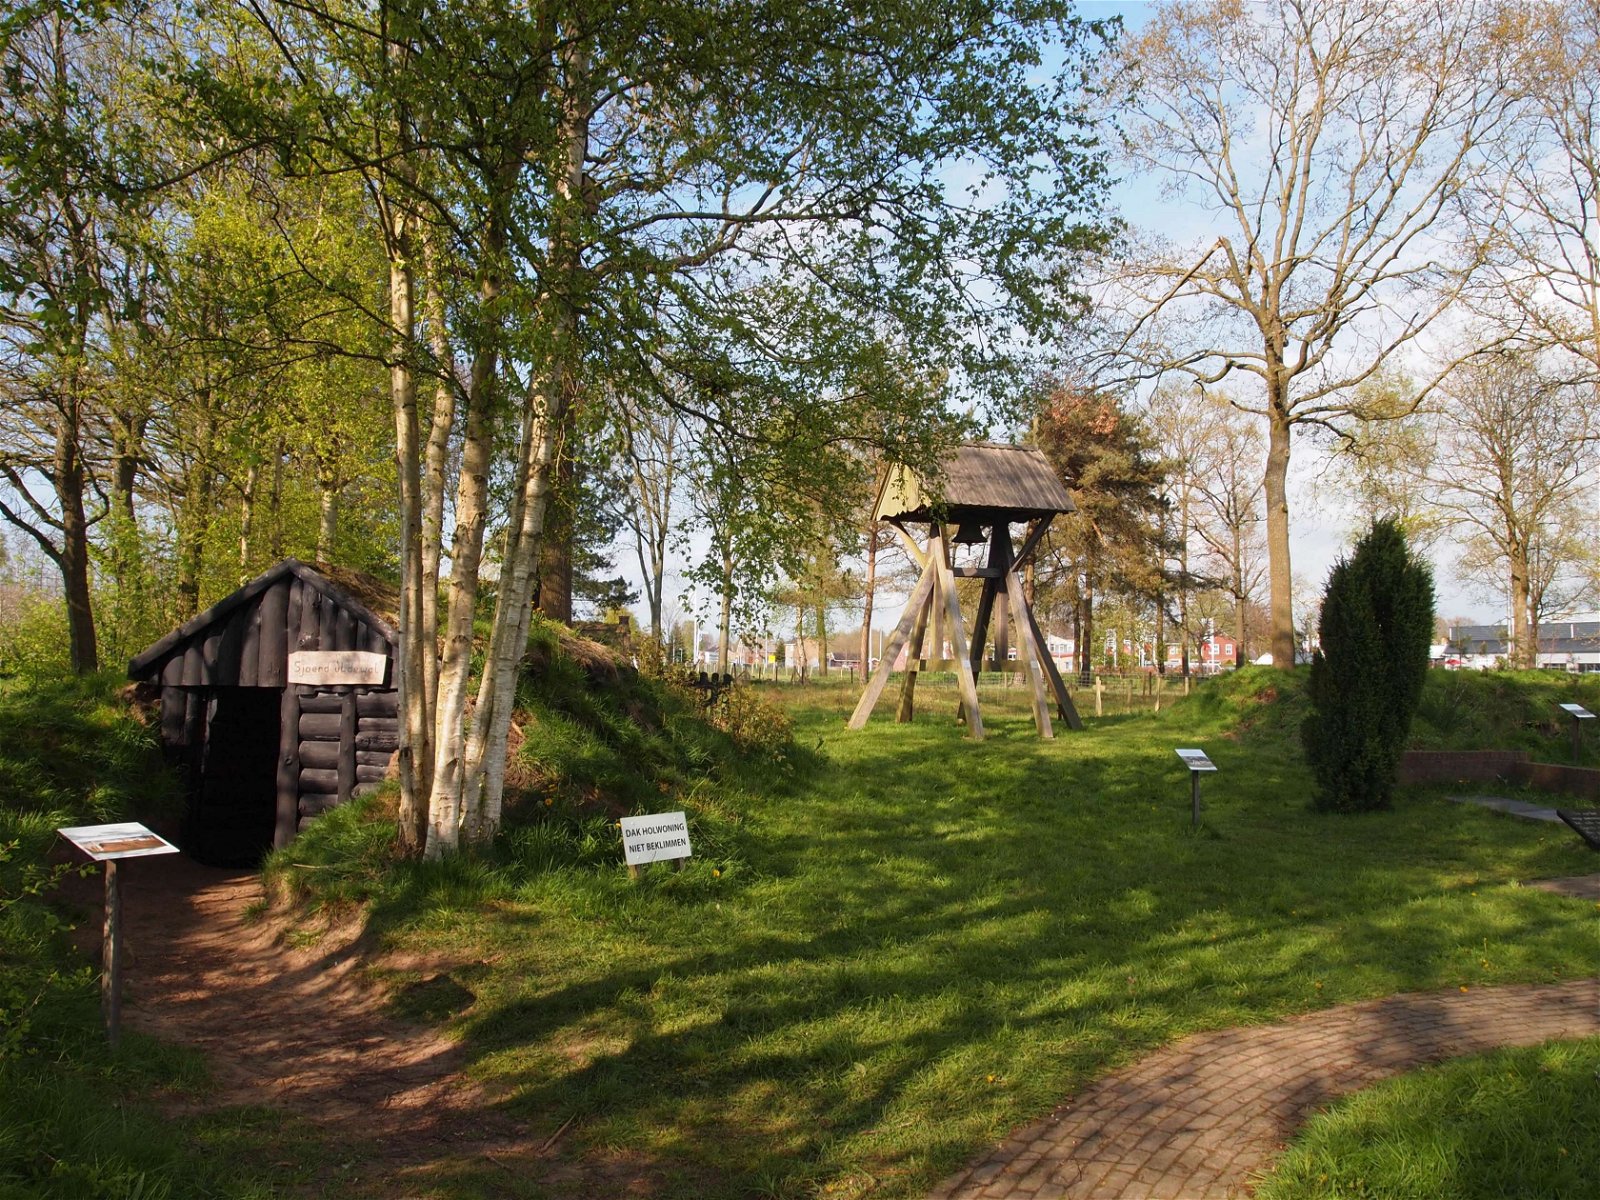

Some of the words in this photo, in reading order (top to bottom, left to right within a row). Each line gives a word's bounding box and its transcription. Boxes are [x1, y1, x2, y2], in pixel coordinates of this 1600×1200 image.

[294, 661, 330, 677] Sjoerd
[625, 828, 642, 838] DAK
[642, 823, 685, 836] HOLWONING
[629, 843, 645, 853] NIET
[646, 838, 687, 851] BEKLIMMEN
